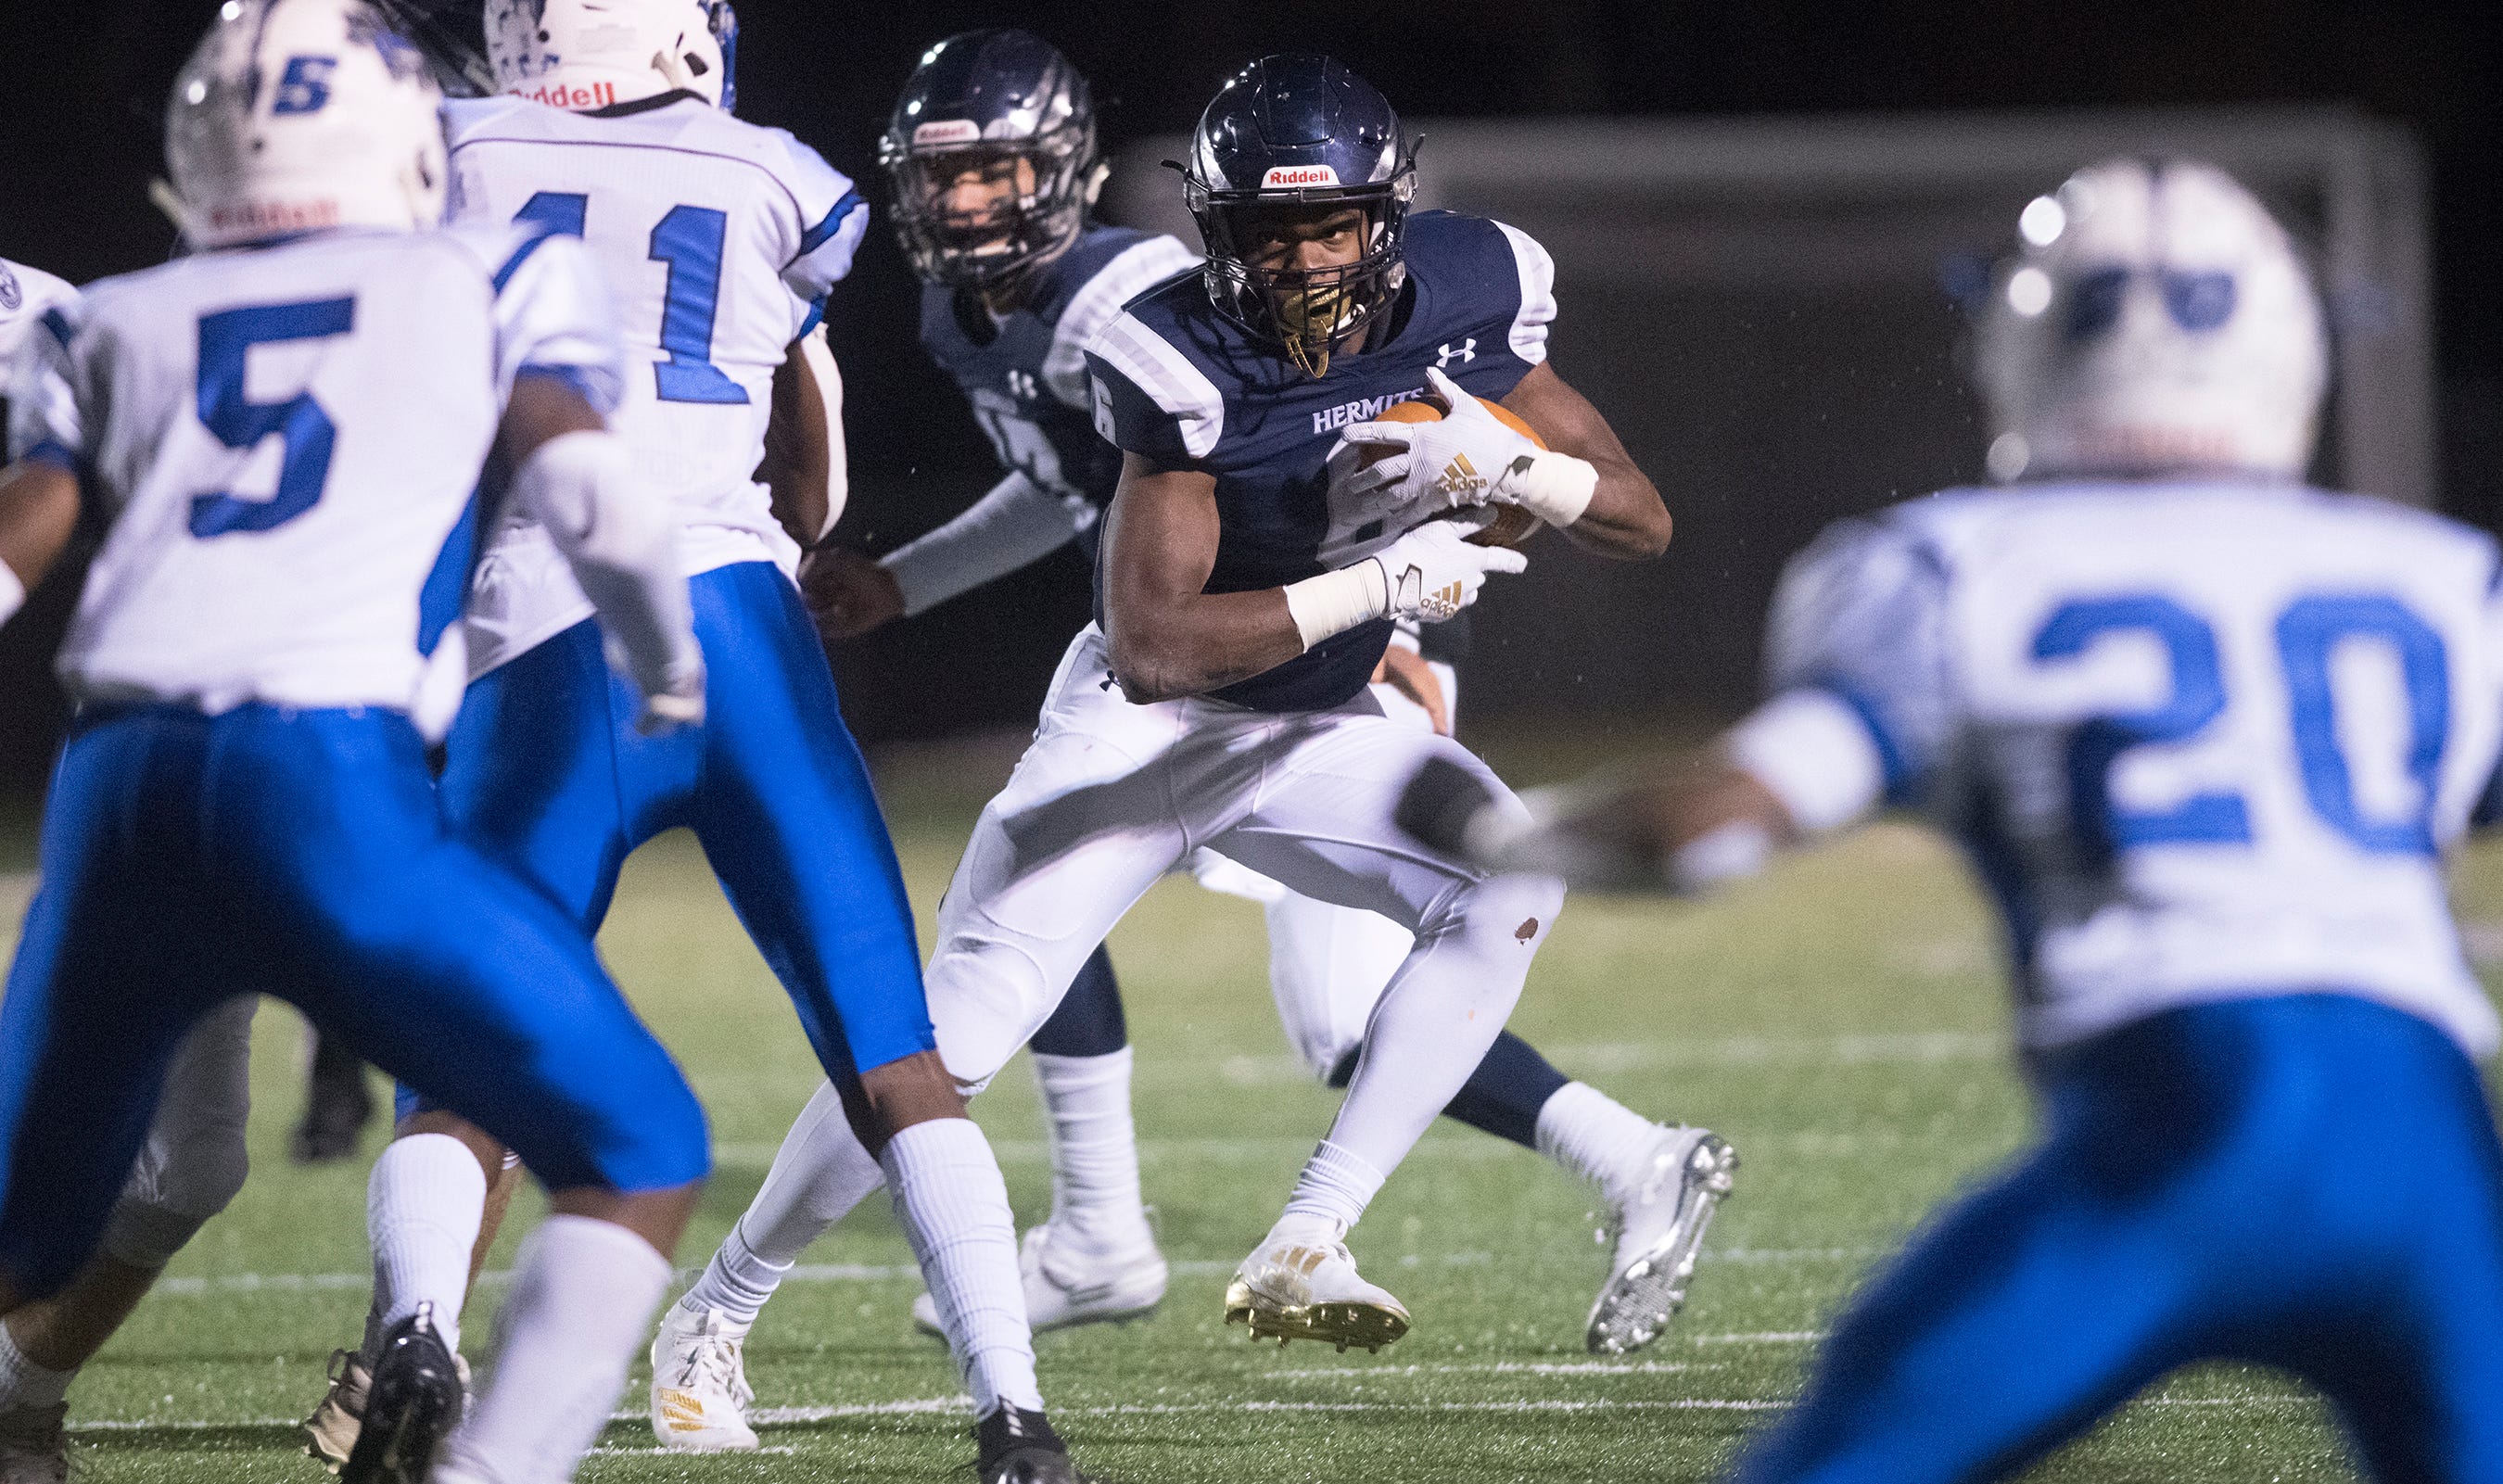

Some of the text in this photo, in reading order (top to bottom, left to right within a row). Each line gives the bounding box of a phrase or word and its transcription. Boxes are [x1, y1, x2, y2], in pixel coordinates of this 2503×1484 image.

[273, 56, 337, 117] 5
[509, 82, 616, 108] ddell
[1269, 170, 1329, 184] Riddell
[187, 297, 357, 539] 5
[2028, 591, 2452, 856] 20
